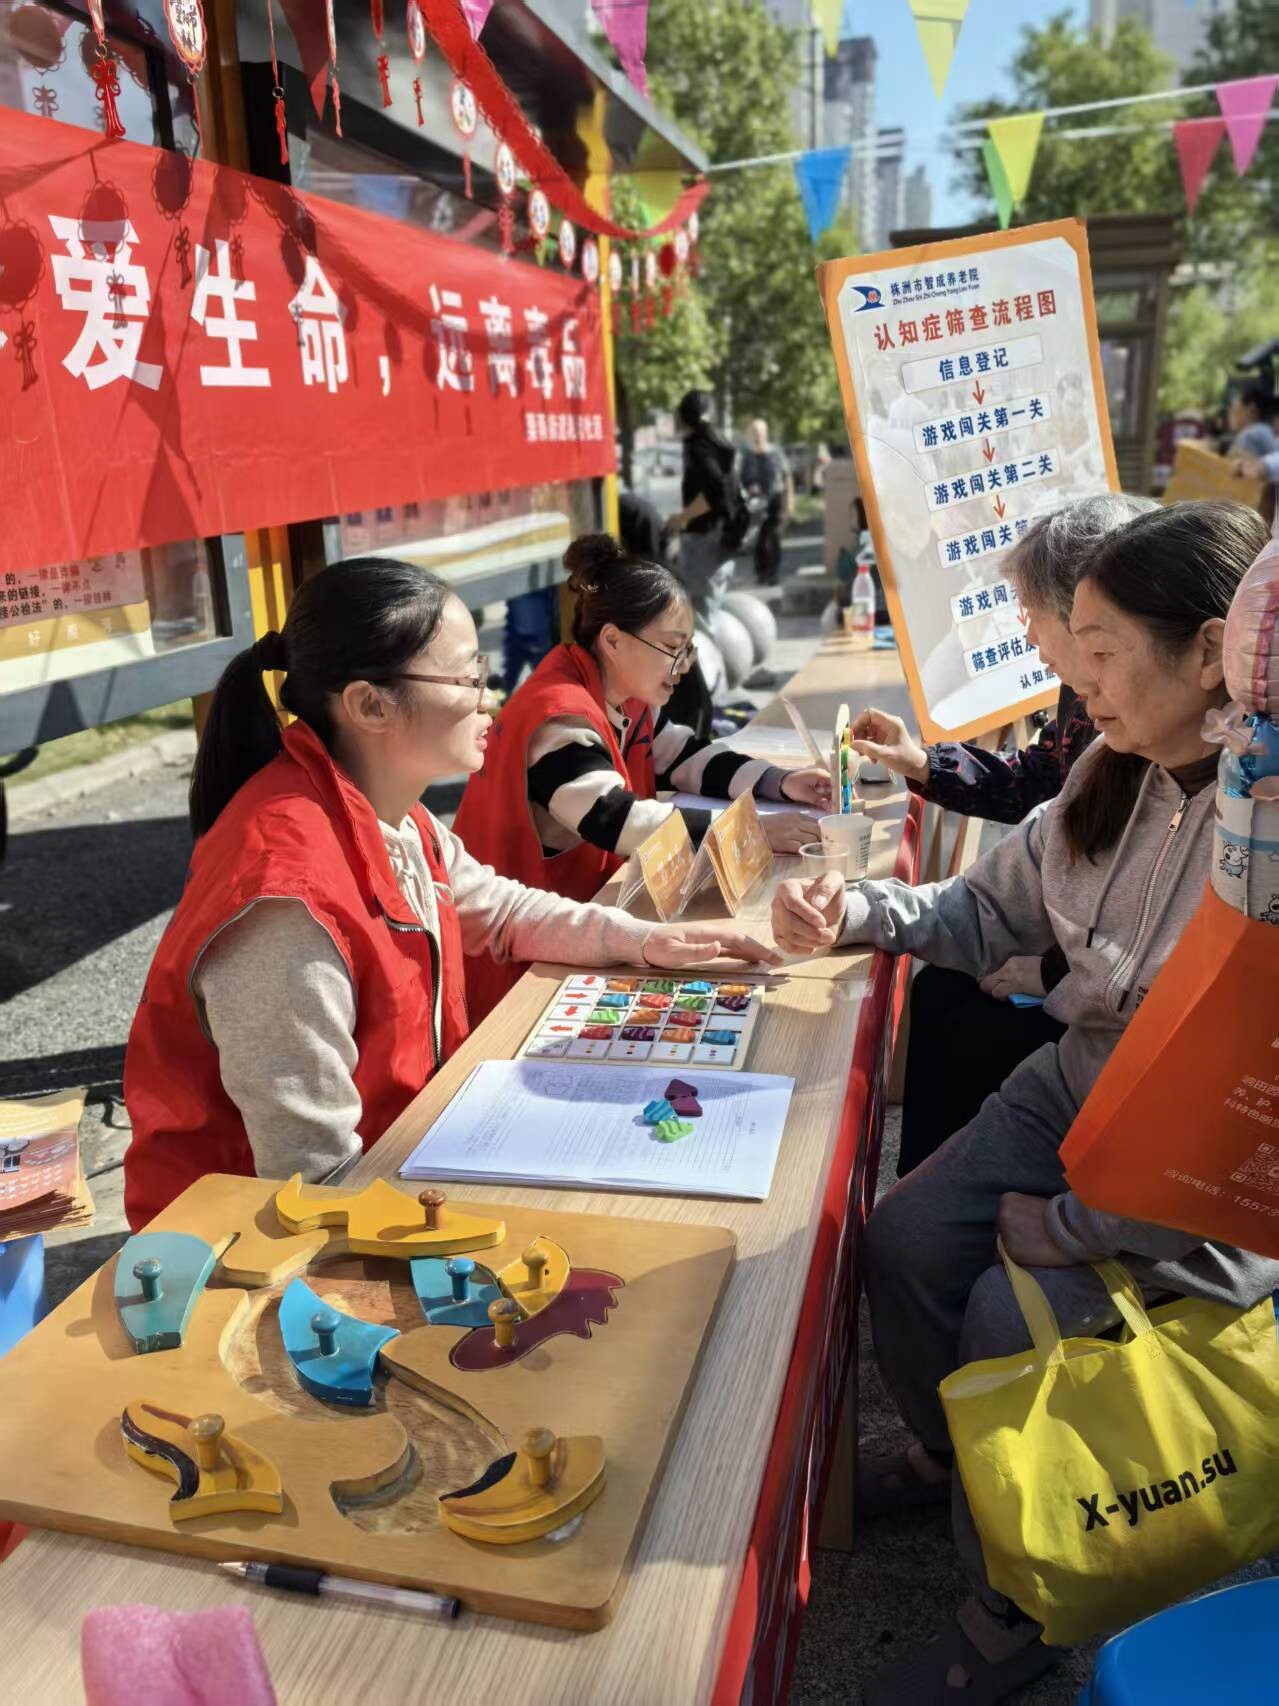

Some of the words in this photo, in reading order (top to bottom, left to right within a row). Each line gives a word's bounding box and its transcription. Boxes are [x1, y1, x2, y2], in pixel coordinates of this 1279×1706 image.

[0, 214, 587, 400] 爱生命，远离毒品
[890, 267, 980, 297] 株洲市智成养老院
[874, 289, 1057, 351] 认知症筛查流程图
[939, 347, 1009, 382] 信息登记
[922, 398, 1044, 447] 游戏闯关第一关
[933, 454, 1053, 505] 游戏闯关第二关
[1076, 1448, 1238, 1532] X-yuan.su
